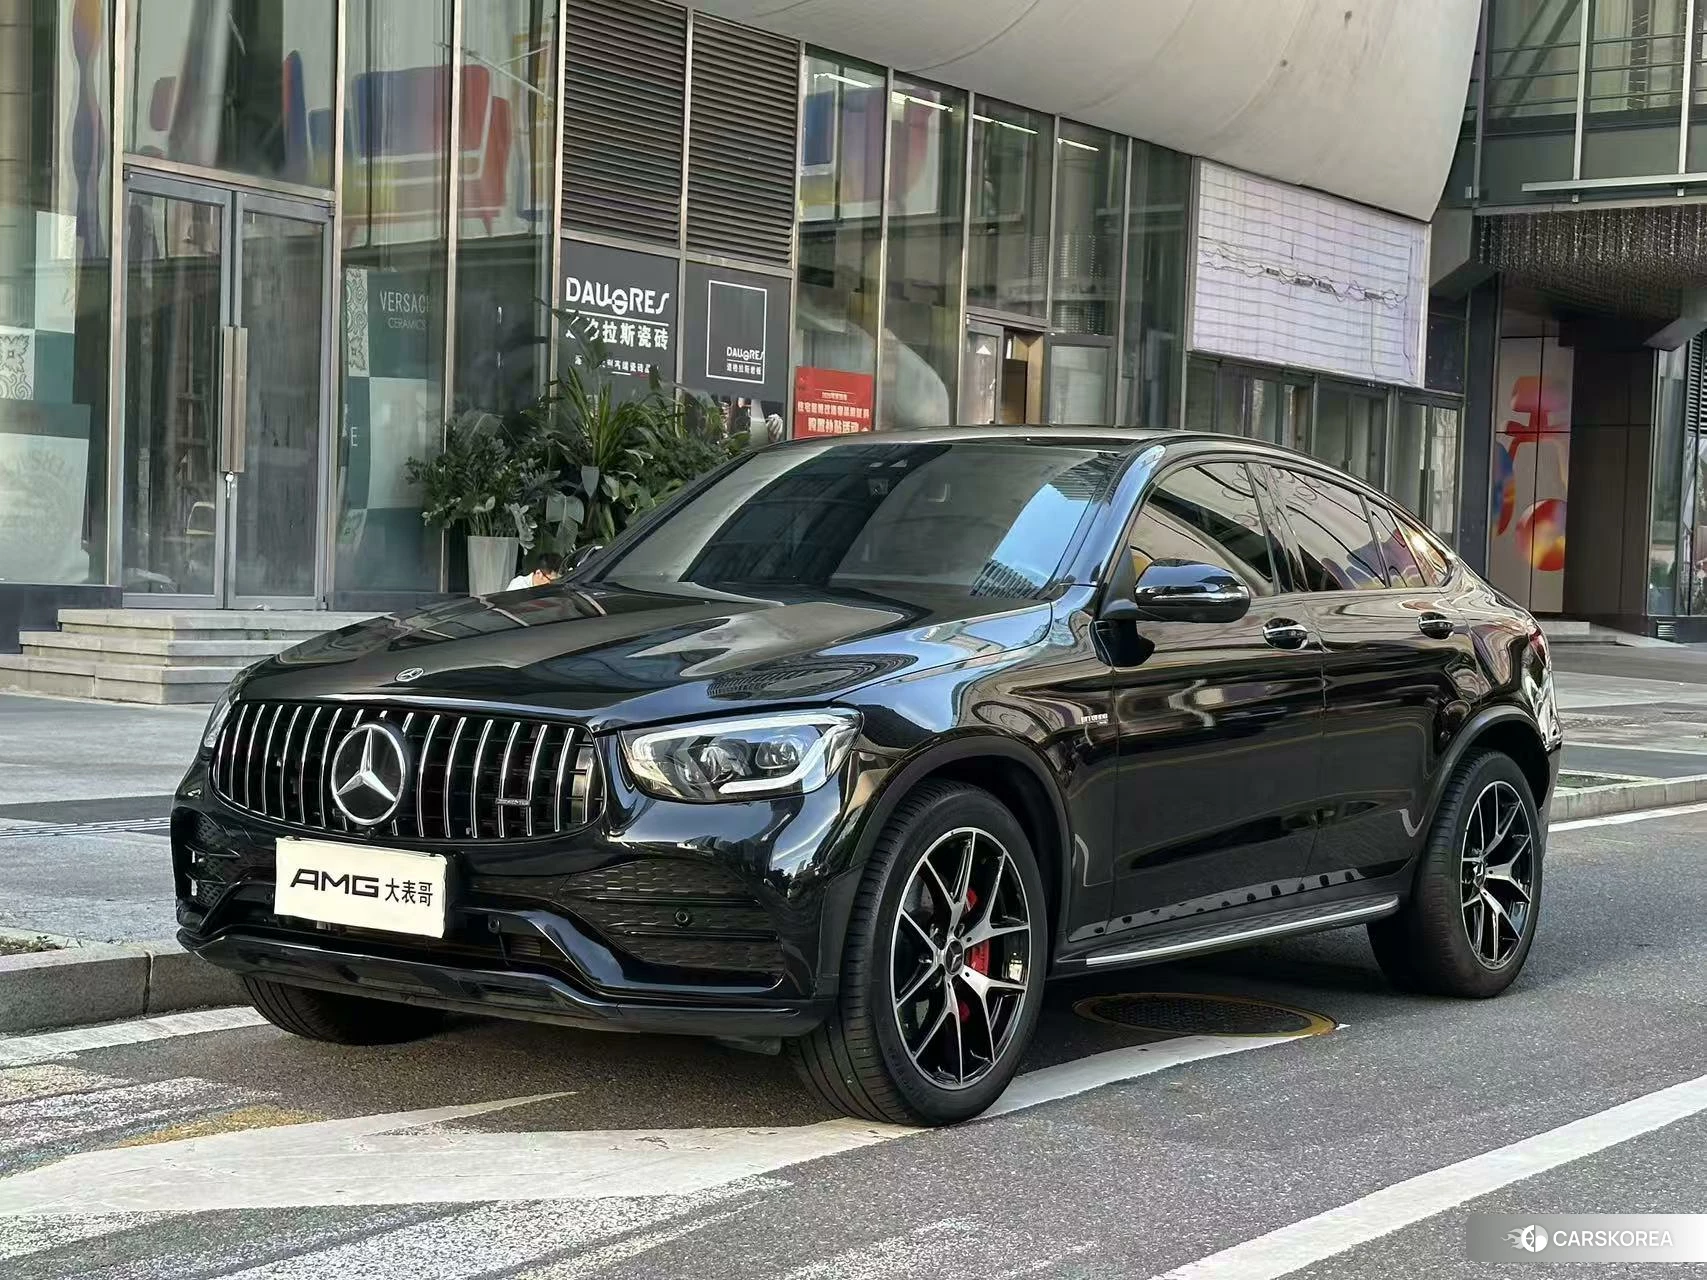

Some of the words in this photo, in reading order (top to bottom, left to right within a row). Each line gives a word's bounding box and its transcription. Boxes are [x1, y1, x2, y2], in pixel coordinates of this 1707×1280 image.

[565, 276, 670, 315] DAUGRES
[726, 346, 765, 361] DAUGRES
[290, 868, 380, 898] AMG
[385, 878, 433, 907] 大表哥
